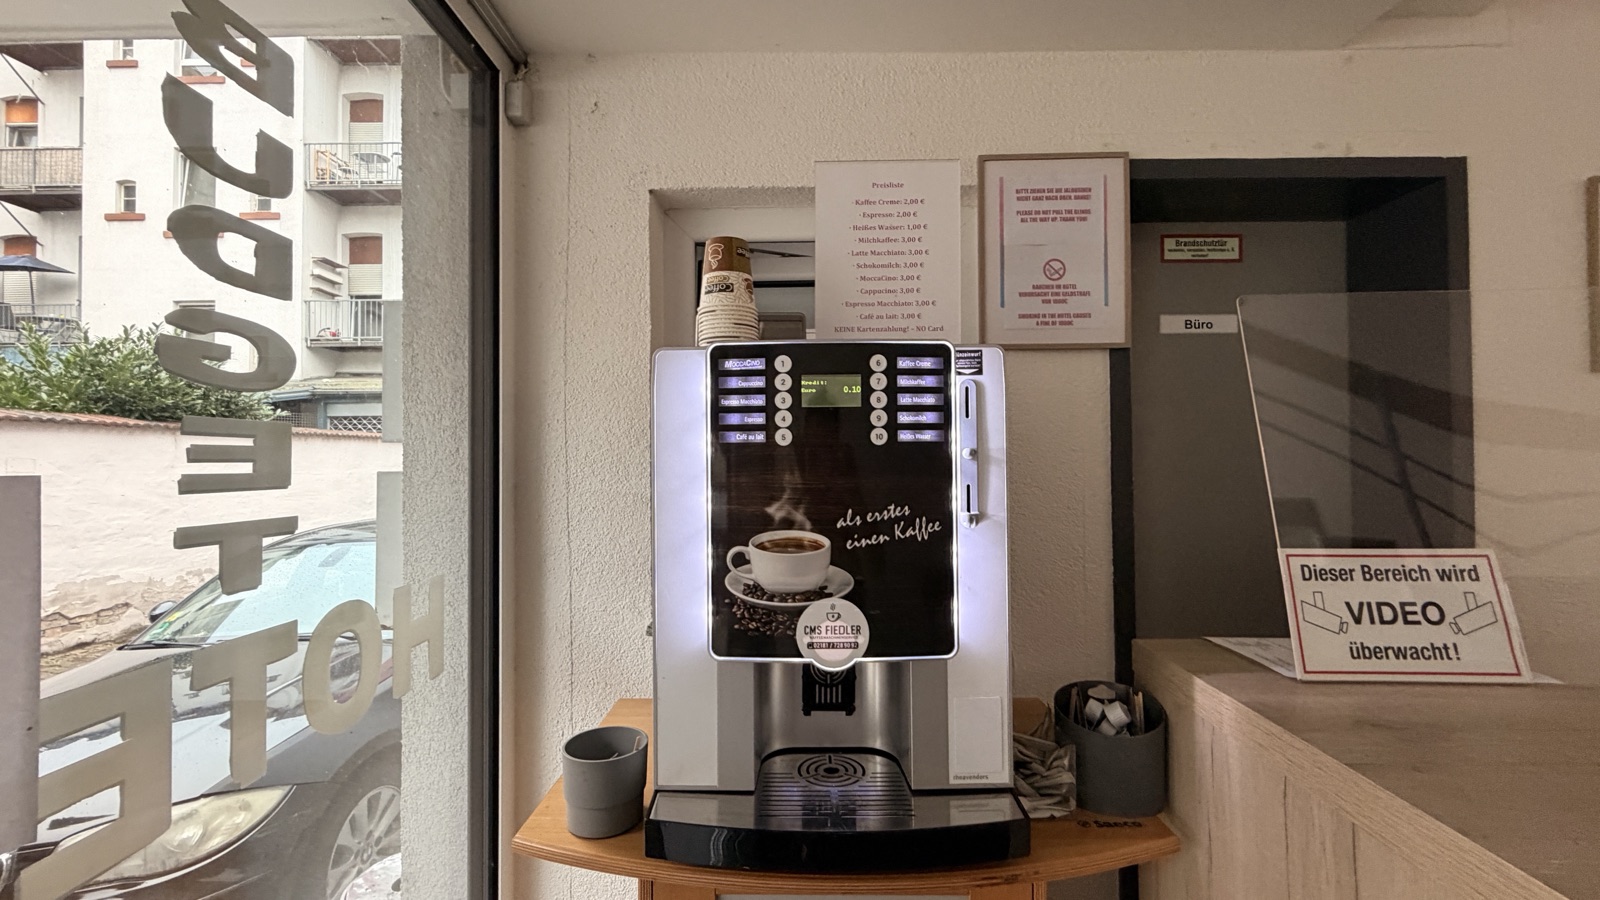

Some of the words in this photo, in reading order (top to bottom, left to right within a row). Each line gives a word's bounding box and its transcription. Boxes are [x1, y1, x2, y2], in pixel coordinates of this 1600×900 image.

[1175, 239, 1228, 247] Brandschutztür
[705, 283, 733, 293] Coffee
[1184, 319, 1213, 330] Büro
[836, 508, 862, 528] als
[866, 503, 911, 522] erstes
[846, 534, 890, 550] einen
[894, 516, 942, 541] Kaffee
[1300, 564, 1355, 582] Dieser
[1360, 564, 1432, 582] Bereich
[1435, 565, 1480, 582] wird
[1344, 601, 1446, 626] VIDEO
[804, 625, 822, 635] CMS
[825, 625, 862, 635] FIEDLER
[1349, 642, 1461, 661] überwacht!
